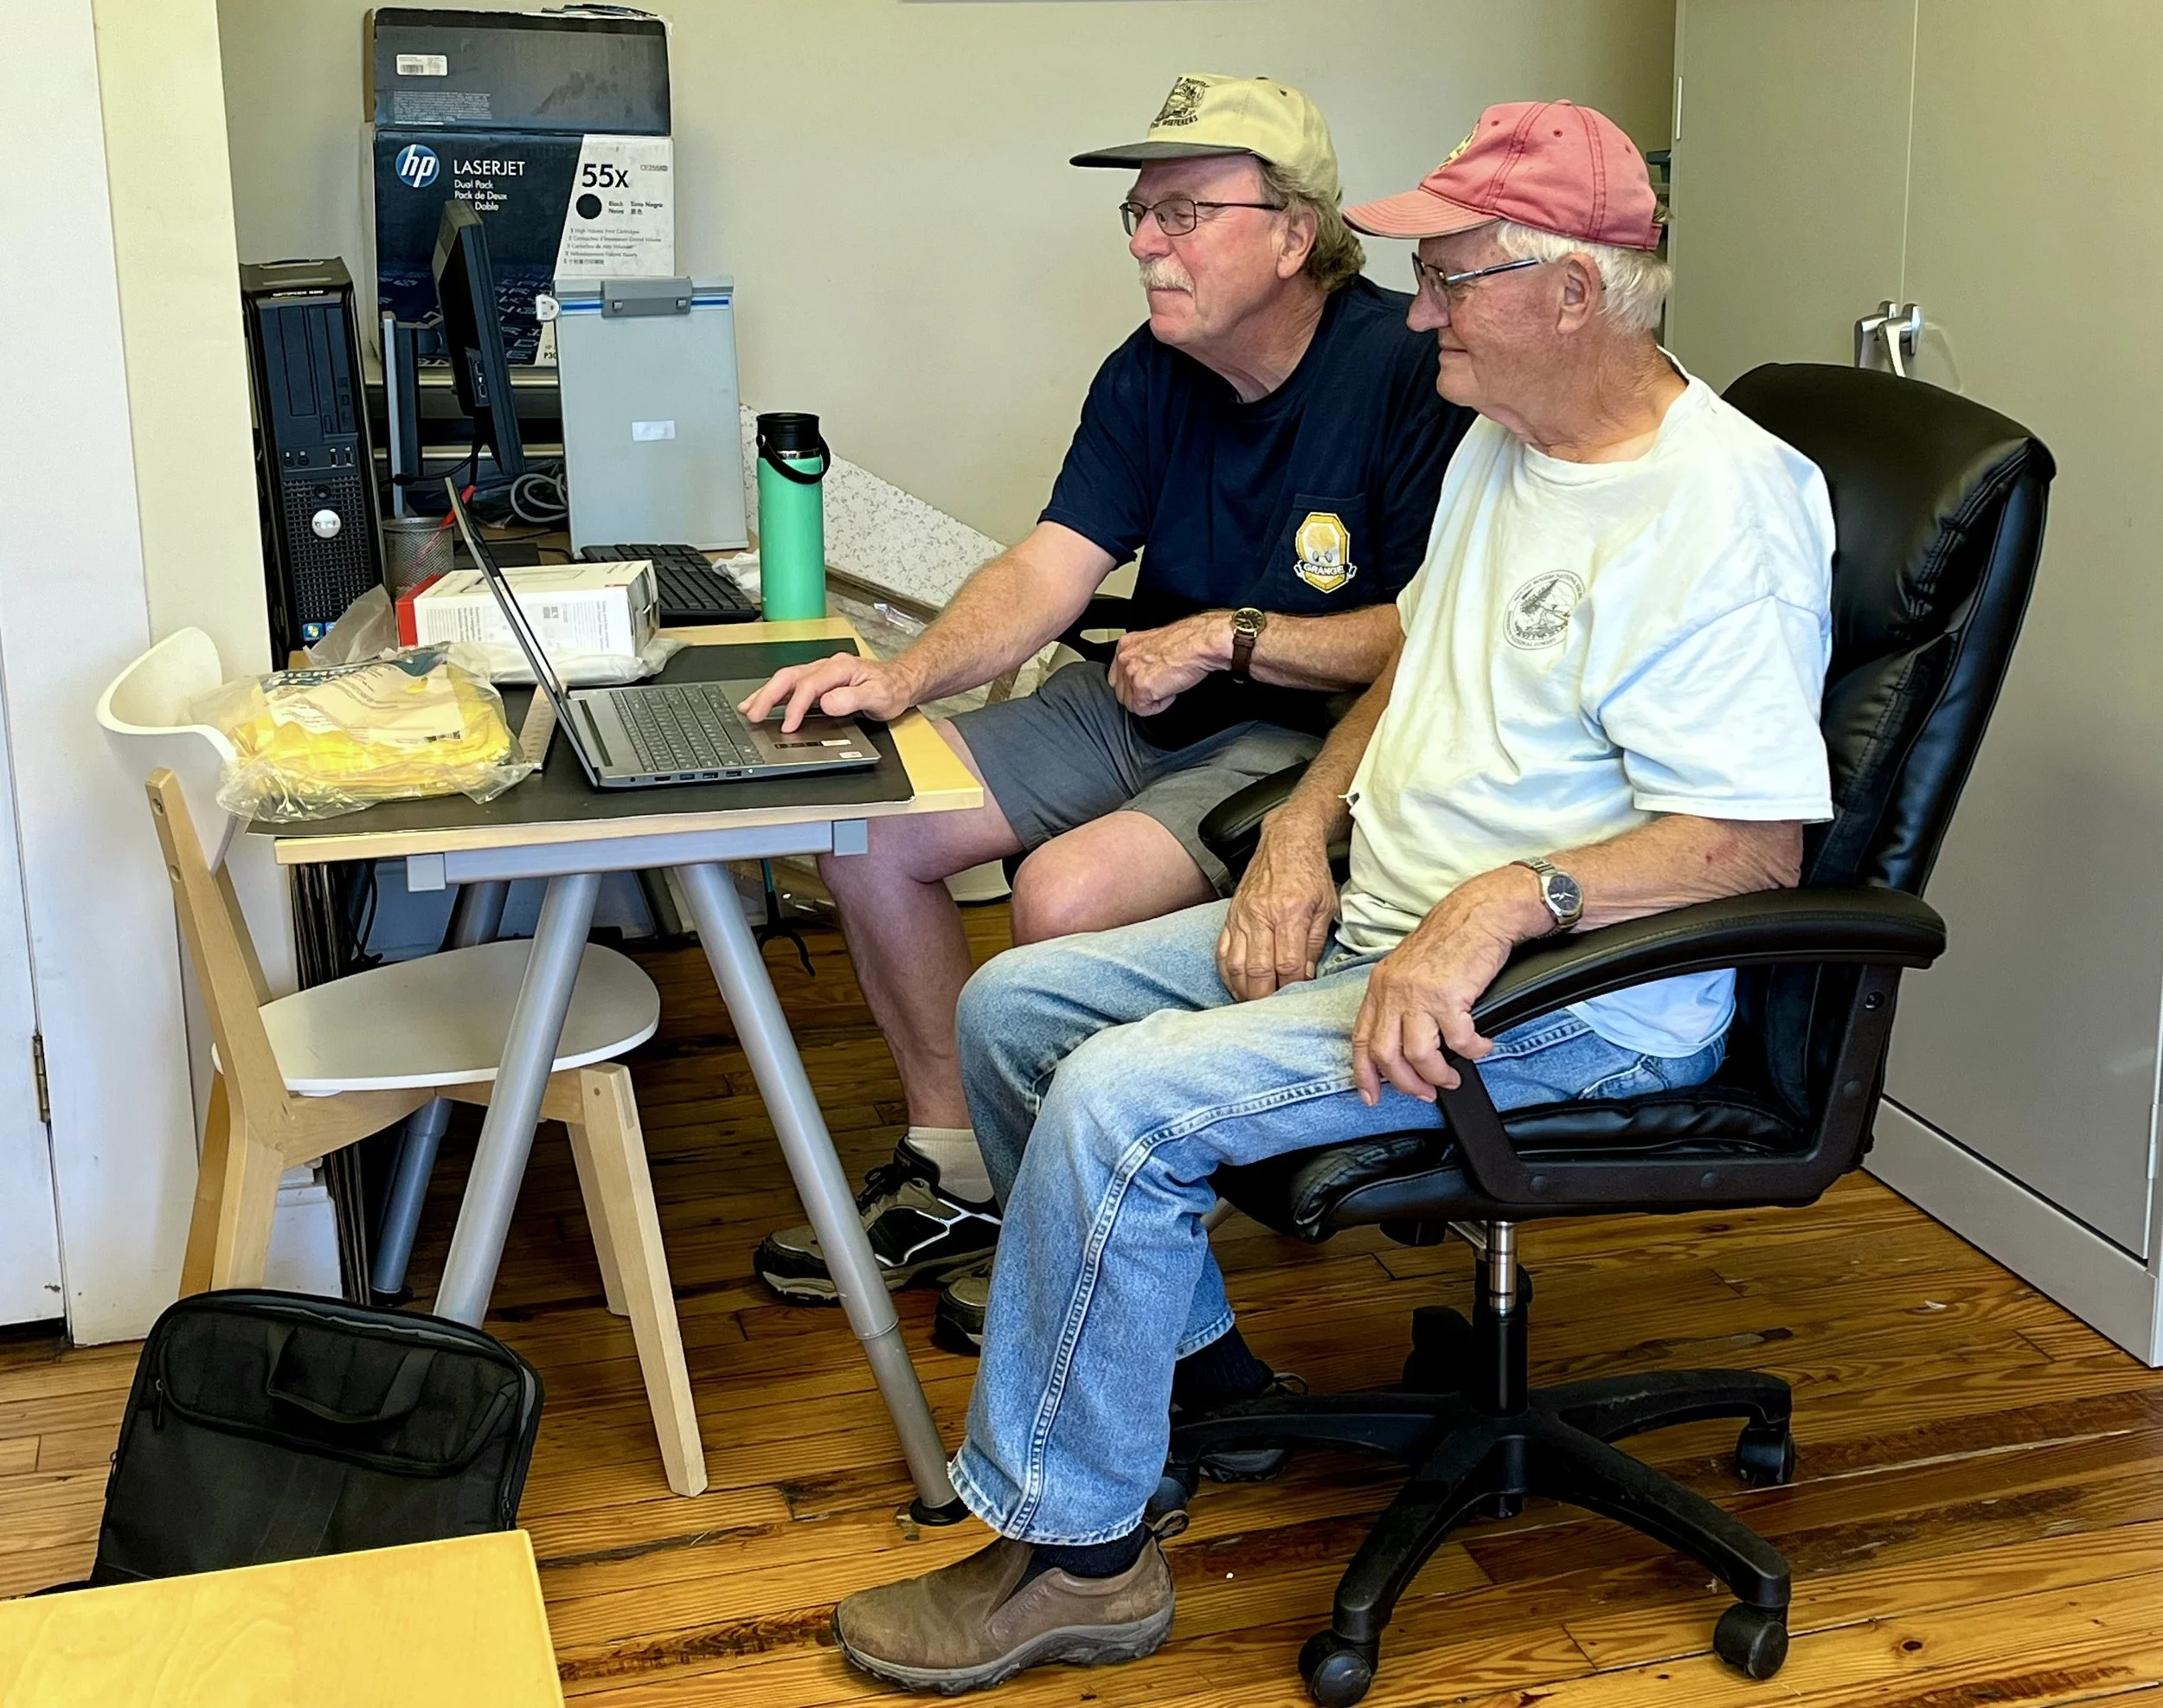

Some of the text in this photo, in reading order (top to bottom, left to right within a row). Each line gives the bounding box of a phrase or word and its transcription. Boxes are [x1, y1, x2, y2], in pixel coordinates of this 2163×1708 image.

[401, 144, 436, 188] hp
[453, 159, 525, 177] LASERJET
[454, 179, 494, 189] Dual Pack
[454, 190, 508, 201] Pack de Deux
[475, 202, 499, 211] Doble
[1303, 563, 1345, 575] GRANGE
